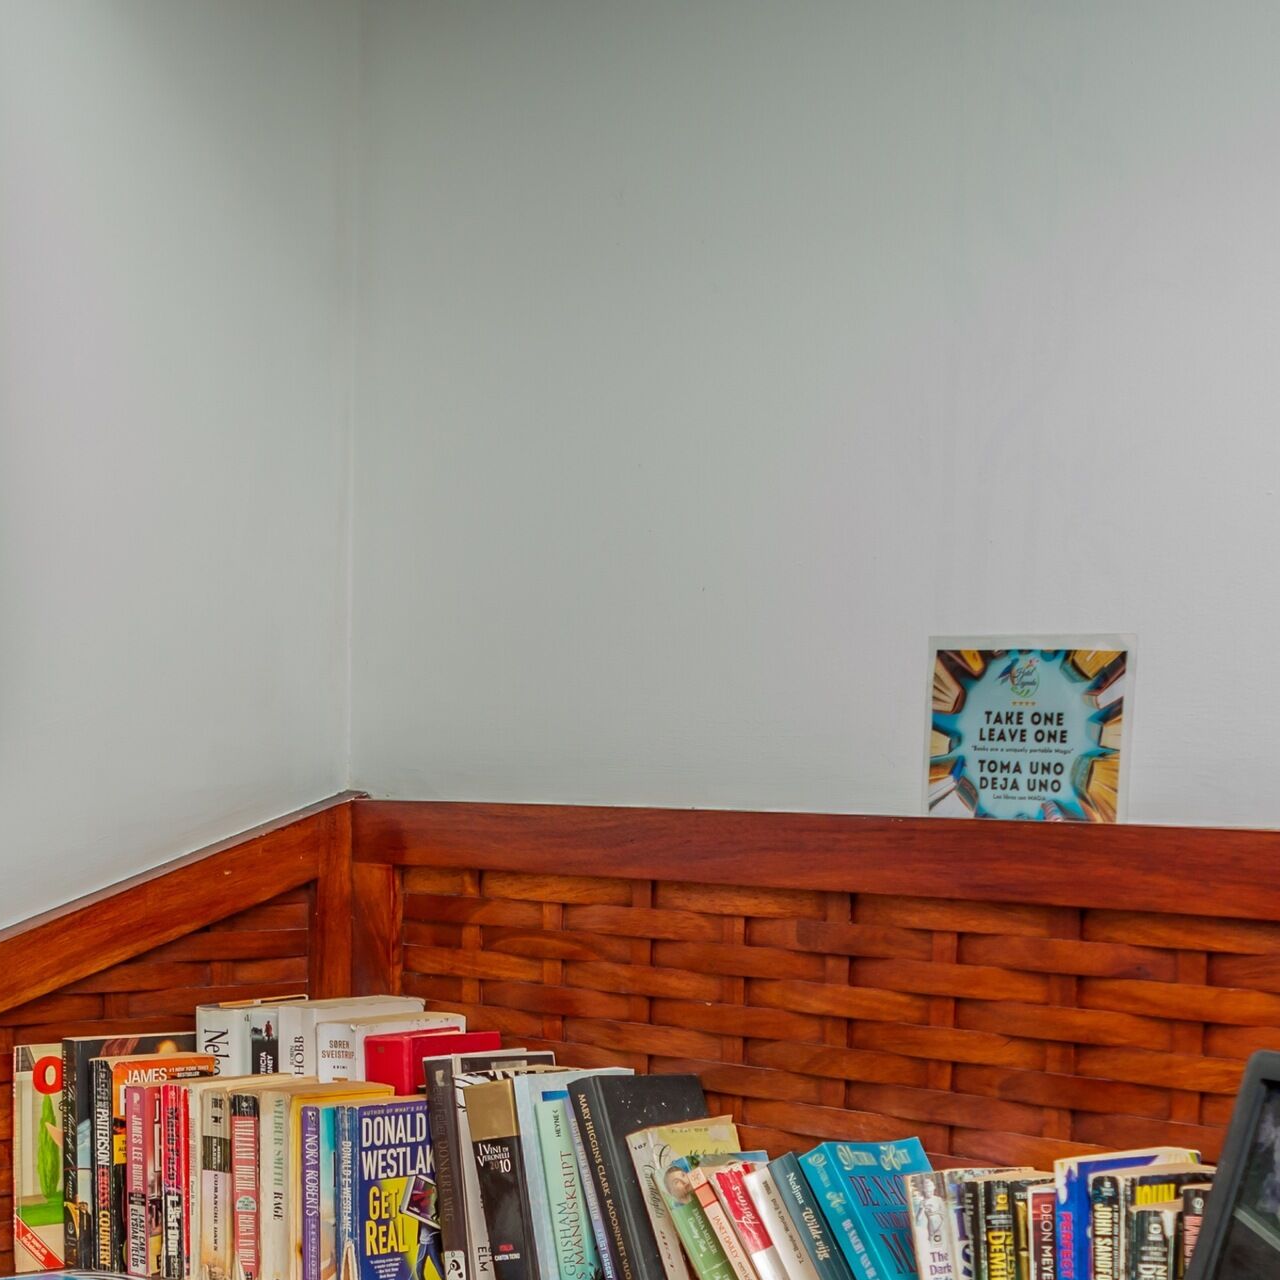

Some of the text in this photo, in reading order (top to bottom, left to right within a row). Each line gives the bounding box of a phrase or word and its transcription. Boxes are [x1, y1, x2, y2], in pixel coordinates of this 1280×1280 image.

[979, 728, 1068, 743] LEAVE ONE
[985, 711, 1064, 726] TAKE ONE
[978, 760, 1064, 775] TOMA UNO
[980, 777, 1061, 793] DEJA UNO
[294, 1035, 305, 1076] HOBB
[329, 1040, 350, 1050] SØREN
[125, 1068, 168, 1086] JAMES
[577, 1092, 592, 1120] MARY
[96, 1108, 110, 1165] PATTERSON
[305, 1133, 318, 1165] NORA
[362, 1113, 426, 1148] DONALD
[584, 1121, 602, 1164] HIGGINS
[132, 1115, 144, 1191] JAMES LEE BURKE
[272, 1099, 284, 1221] WILBUR SMITH RAGE
[489, 1158, 512, 1173] 2010
[97, 1168, 109, 1207] CROSS
[305, 1169, 318, 1217] ROBERTS
[595, 1164, 610, 1196] CLARK
[369, 1185, 400, 1221] GET
[563, 1150, 586, 1265] MANUSKRIPT
[786, 1172, 831, 1262] Nedjma Wilde vijg
[1093, 1204, 1112, 1237] JOHN
[98, 1210, 111, 1267] COUNTRY
[131, 1208, 140, 1268] ELYSIAN FIELDS
[167, 1195, 181, 1256] Last Don
[365, 1219, 409, 1257] REAL
[559, 1201, 576, 1276] GRISHAM
[603, 1199, 626, 1257] KADONNEET
[1040, 1204, 1053, 1243] DEON
[139, 1253, 146, 1265] TO
[930, 1251, 949, 1263] The
[1060, 1210, 1074, 1278] PERFECT
[929, 1263, 953, 1276] Dark
